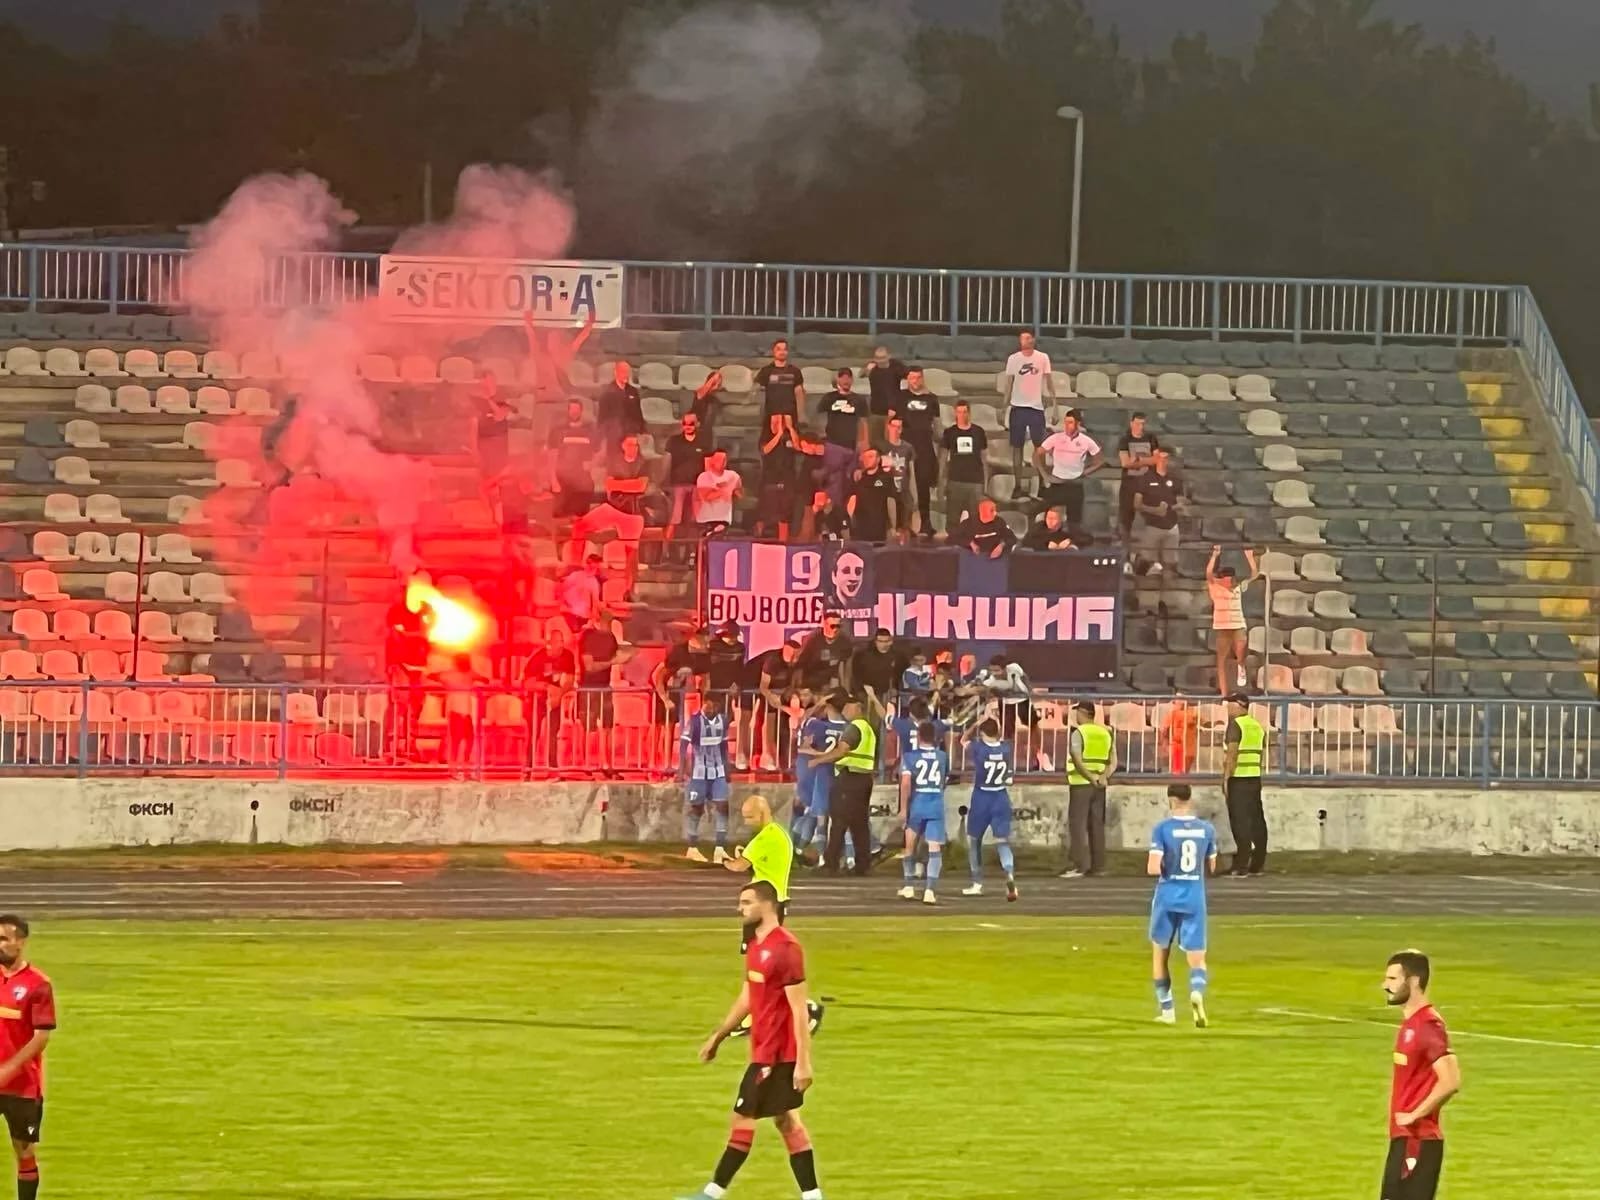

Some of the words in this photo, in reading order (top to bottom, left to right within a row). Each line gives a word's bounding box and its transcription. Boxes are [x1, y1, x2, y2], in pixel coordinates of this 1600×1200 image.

[408, 269, 553, 312] SEKTOR
[570, 274, 596, 316] A
[915, 759, 941, 786] 24
[984, 761, 1007, 785] 72
[1180, 839, 1197, 873] 8
